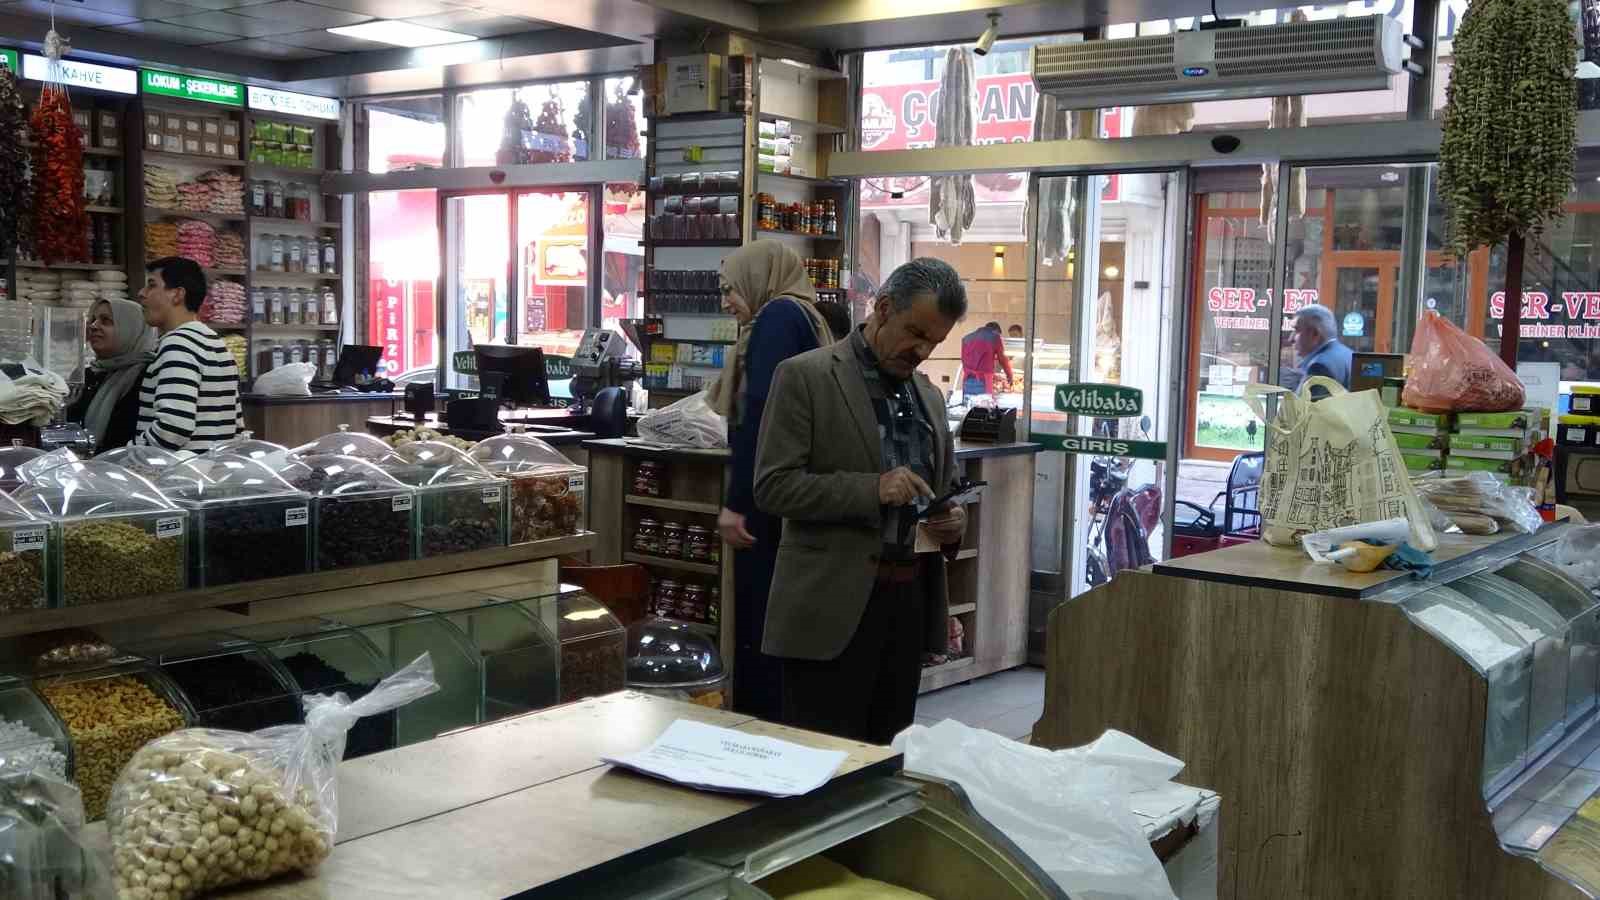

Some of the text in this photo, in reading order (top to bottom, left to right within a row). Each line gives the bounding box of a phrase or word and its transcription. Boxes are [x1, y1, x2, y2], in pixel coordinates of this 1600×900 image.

[62, 66, 103, 84] KAHVE
[147, 73, 180, 90] LOKUM
[903, 84, 1033, 136] ÇAN
[1059, 389, 1139, 412] Velibaba
[1061, 438, 1129, 456] GİRİŞ
